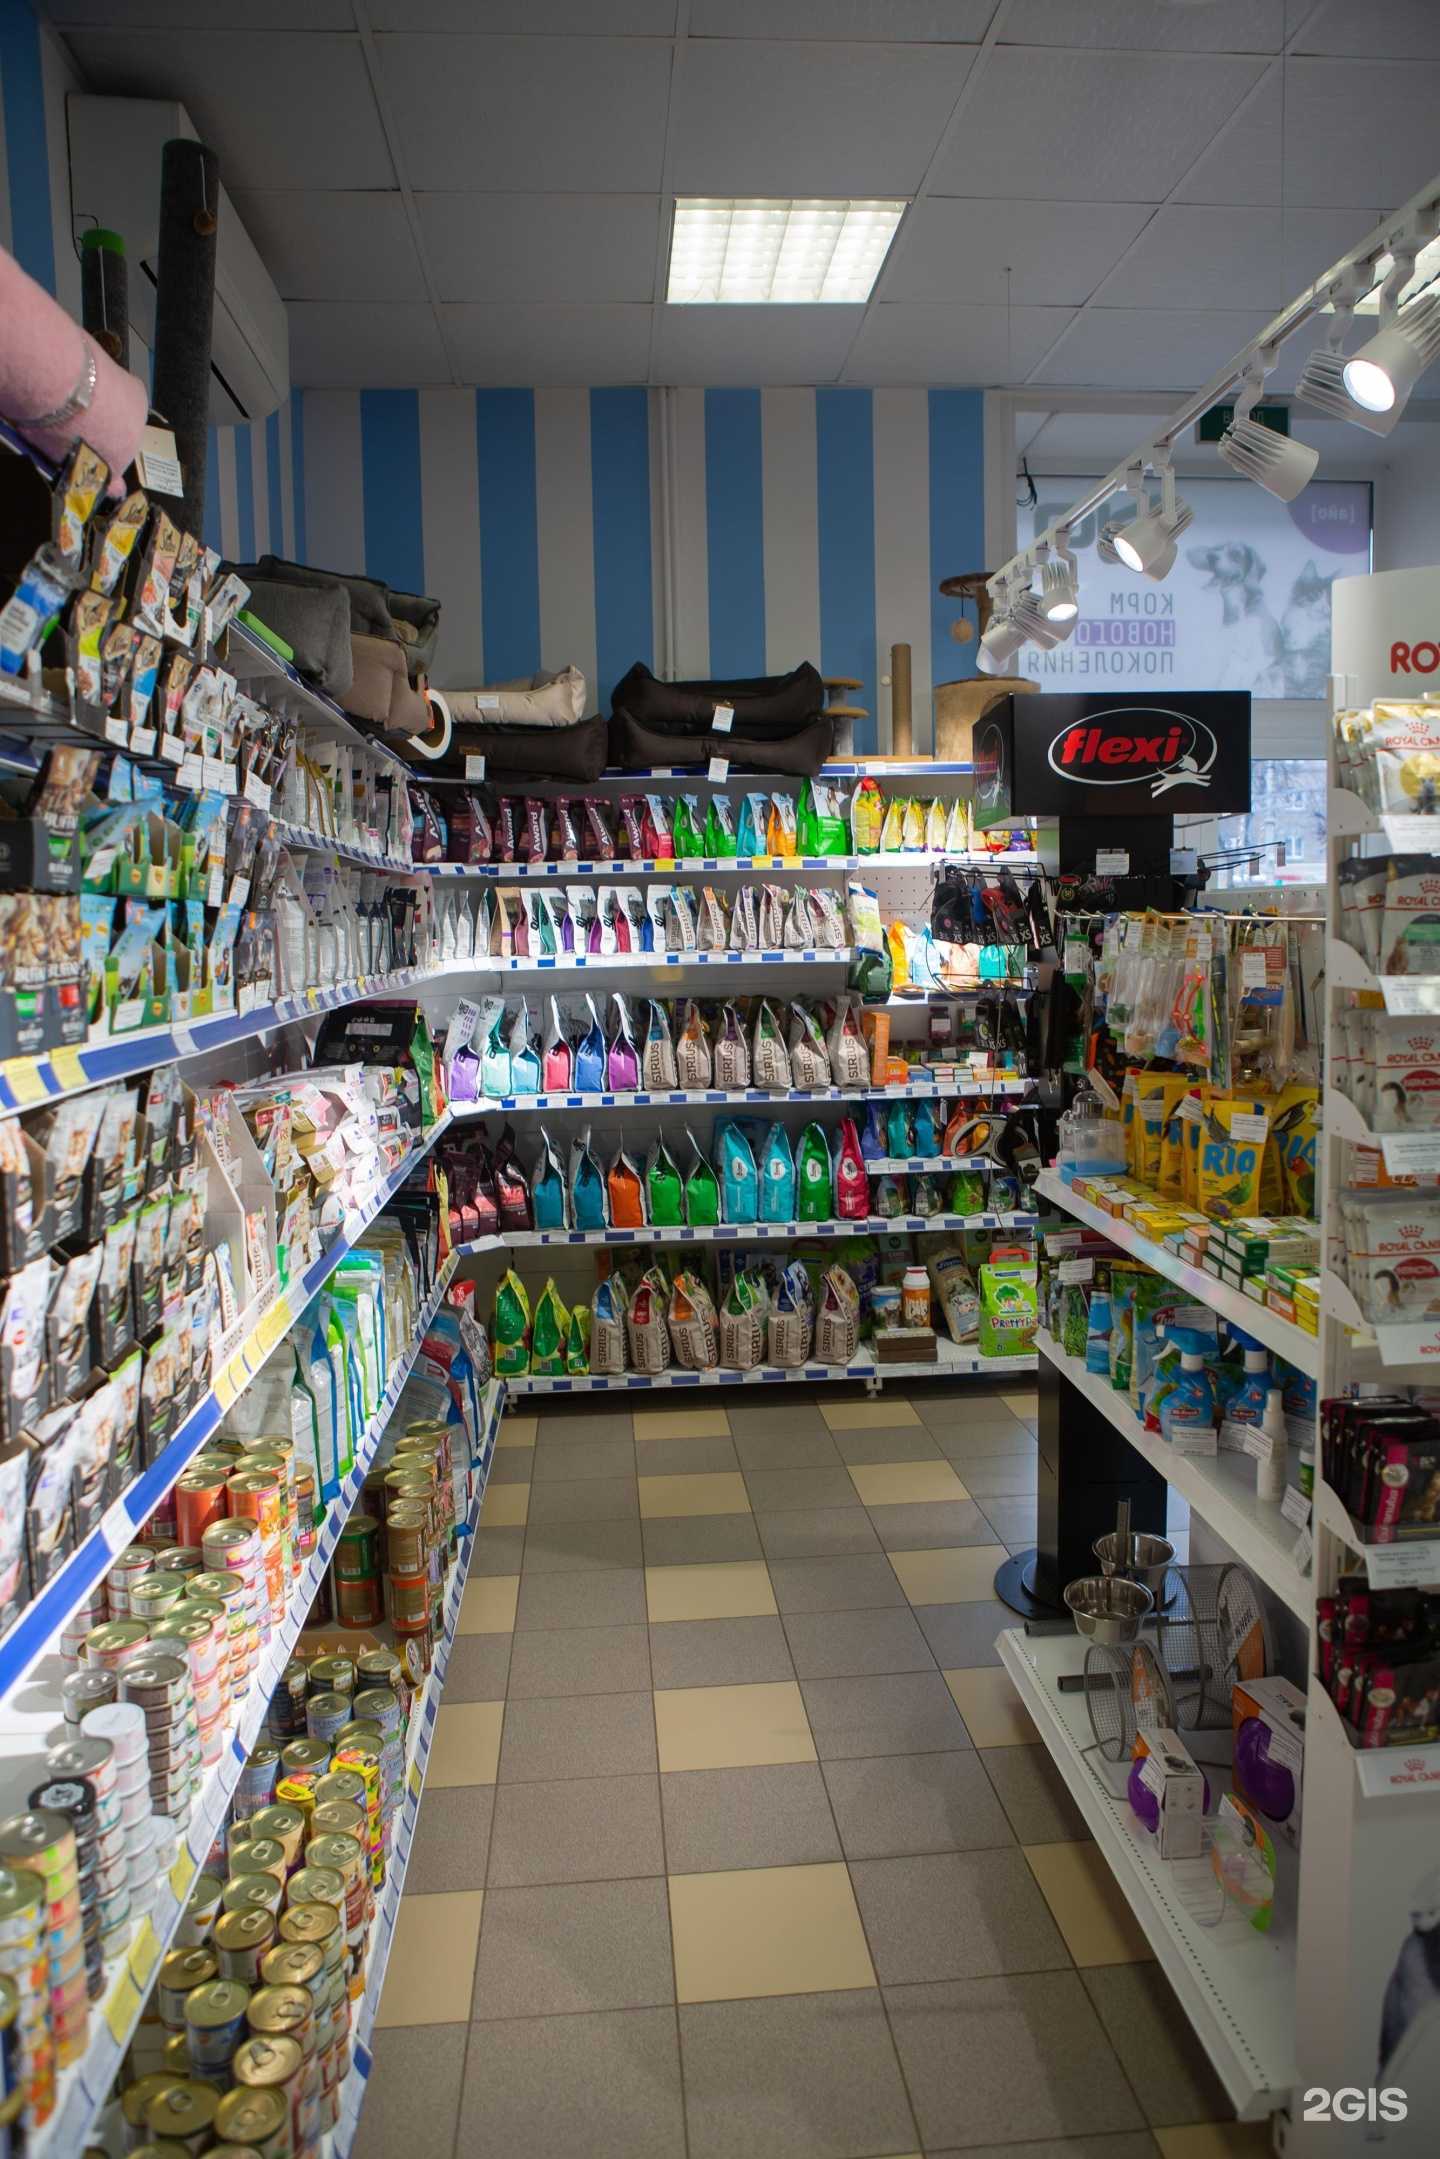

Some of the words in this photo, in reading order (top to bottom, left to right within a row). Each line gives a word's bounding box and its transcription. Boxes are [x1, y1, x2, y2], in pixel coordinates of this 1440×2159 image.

[1391, 641, 1440, 674] RO
[1061, 727, 1182, 764] flexi
[1385, 736, 1417, 746] ROYAL
[506, 808, 514, 849] Award
[530, 811, 541, 852] Award
[560, 809, 574, 849] Award
[623, 808, 642, 848] Award
[711, 903, 723, 940] SIRIUS
[1020, 928, 1032, 941] XS
[1040, 932, 1052, 945] XS
[650, 1043, 661, 1083] SIRIUS
[686, 1041, 697, 1081] SIRIUS
[724, 1043, 733, 1082] SIRIUS
[764, 1041, 775, 1081] SIRIUS
[801, 1044, 815, 1083] SIRIUS
[845, 1038, 858, 1078] SIRIUS
[1387, 1053, 1418, 1064] ROYAL
[1203, 1144, 1256, 1177] RIO
[635, 1332, 643, 1367] SIRIUS
[680, 1327, 693, 1365] SIRIUS
[727, 1323, 735, 1359] SIRIUS
[775, 1319, 785, 1356] SIRIUS
[823, 1318, 832, 1352] SIRIUS
